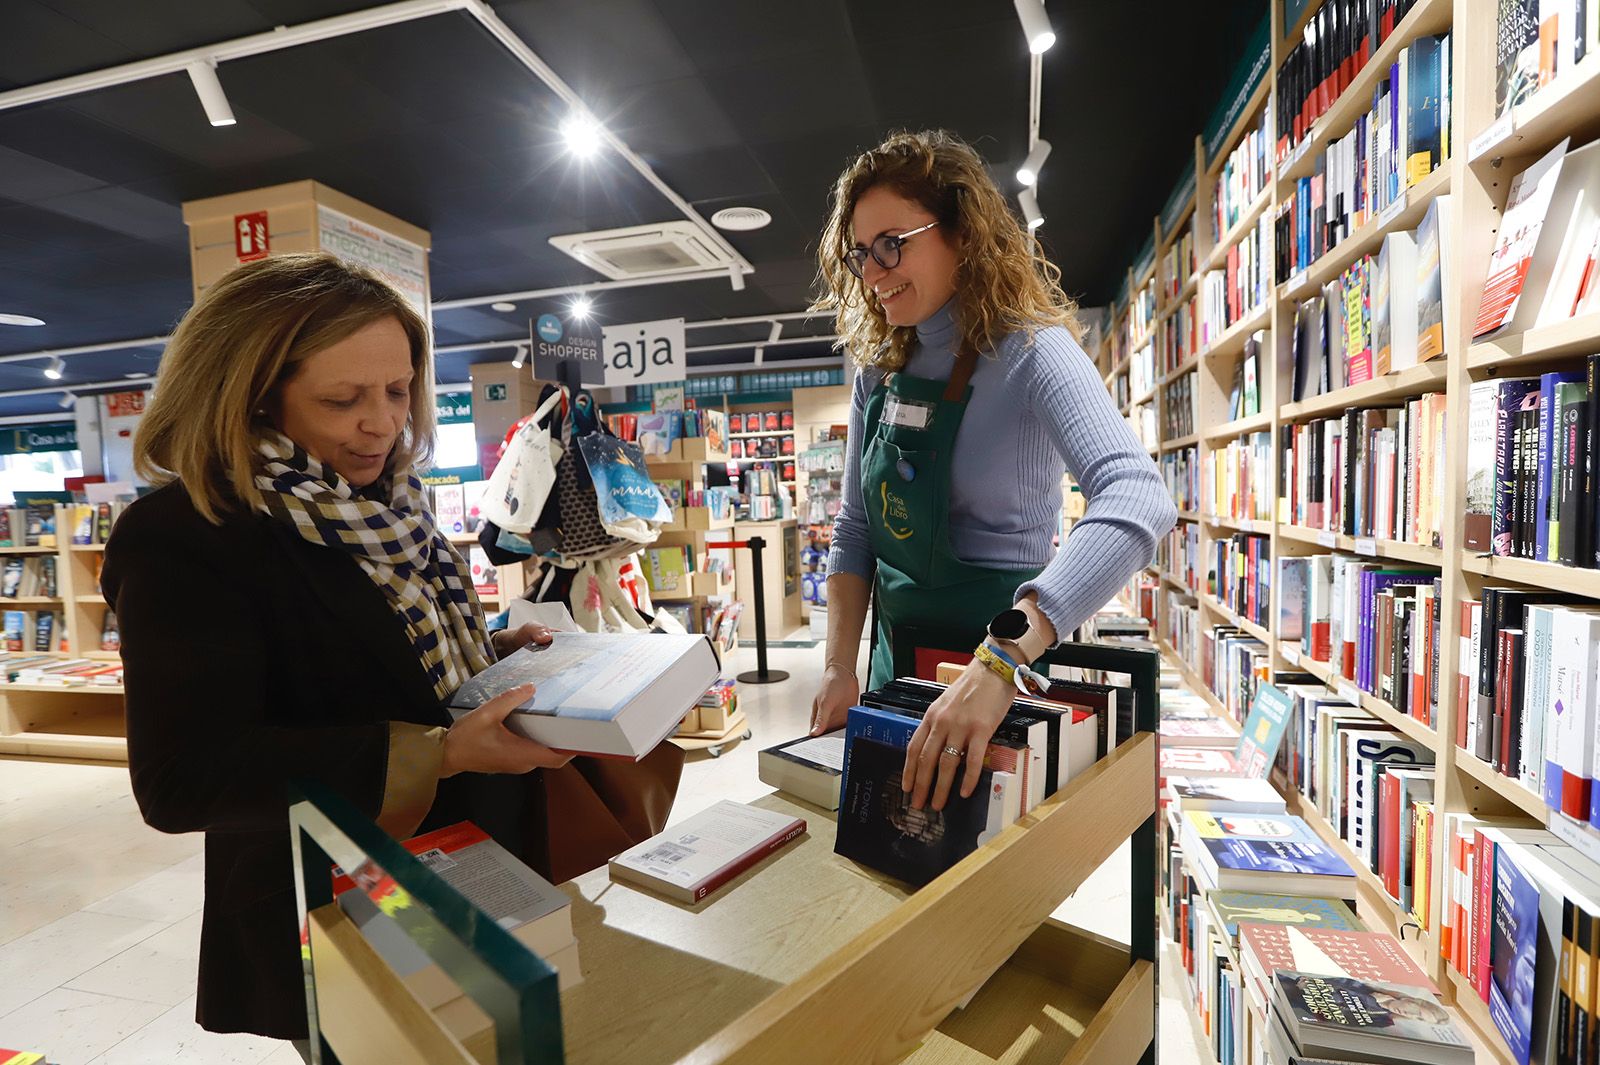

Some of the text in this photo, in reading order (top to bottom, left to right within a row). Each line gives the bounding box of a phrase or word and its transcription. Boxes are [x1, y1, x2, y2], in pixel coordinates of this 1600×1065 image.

[539, 342, 598, 360] SHOPPER
[568, 336, 597, 347] DESIGN
[603, 329, 674, 378] aja
[456, 404, 470, 416] del
[28, 432, 54, 446] Casa
[1496, 408, 1508, 476] PLANETARIO
[886, 492, 904, 506] Casa
[890, 506, 908, 520] Libro
[1495, 506, 1504, 532] LÓPEZ
[1558, 665, 1566, 694] Marsé
[860, 780, 872, 824] STONER
[785, 826, 803, 841] HUXLEY
[1302, 994, 1319, 1014] DIOS
[1314, 978, 1349, 1024] RENGLONES
